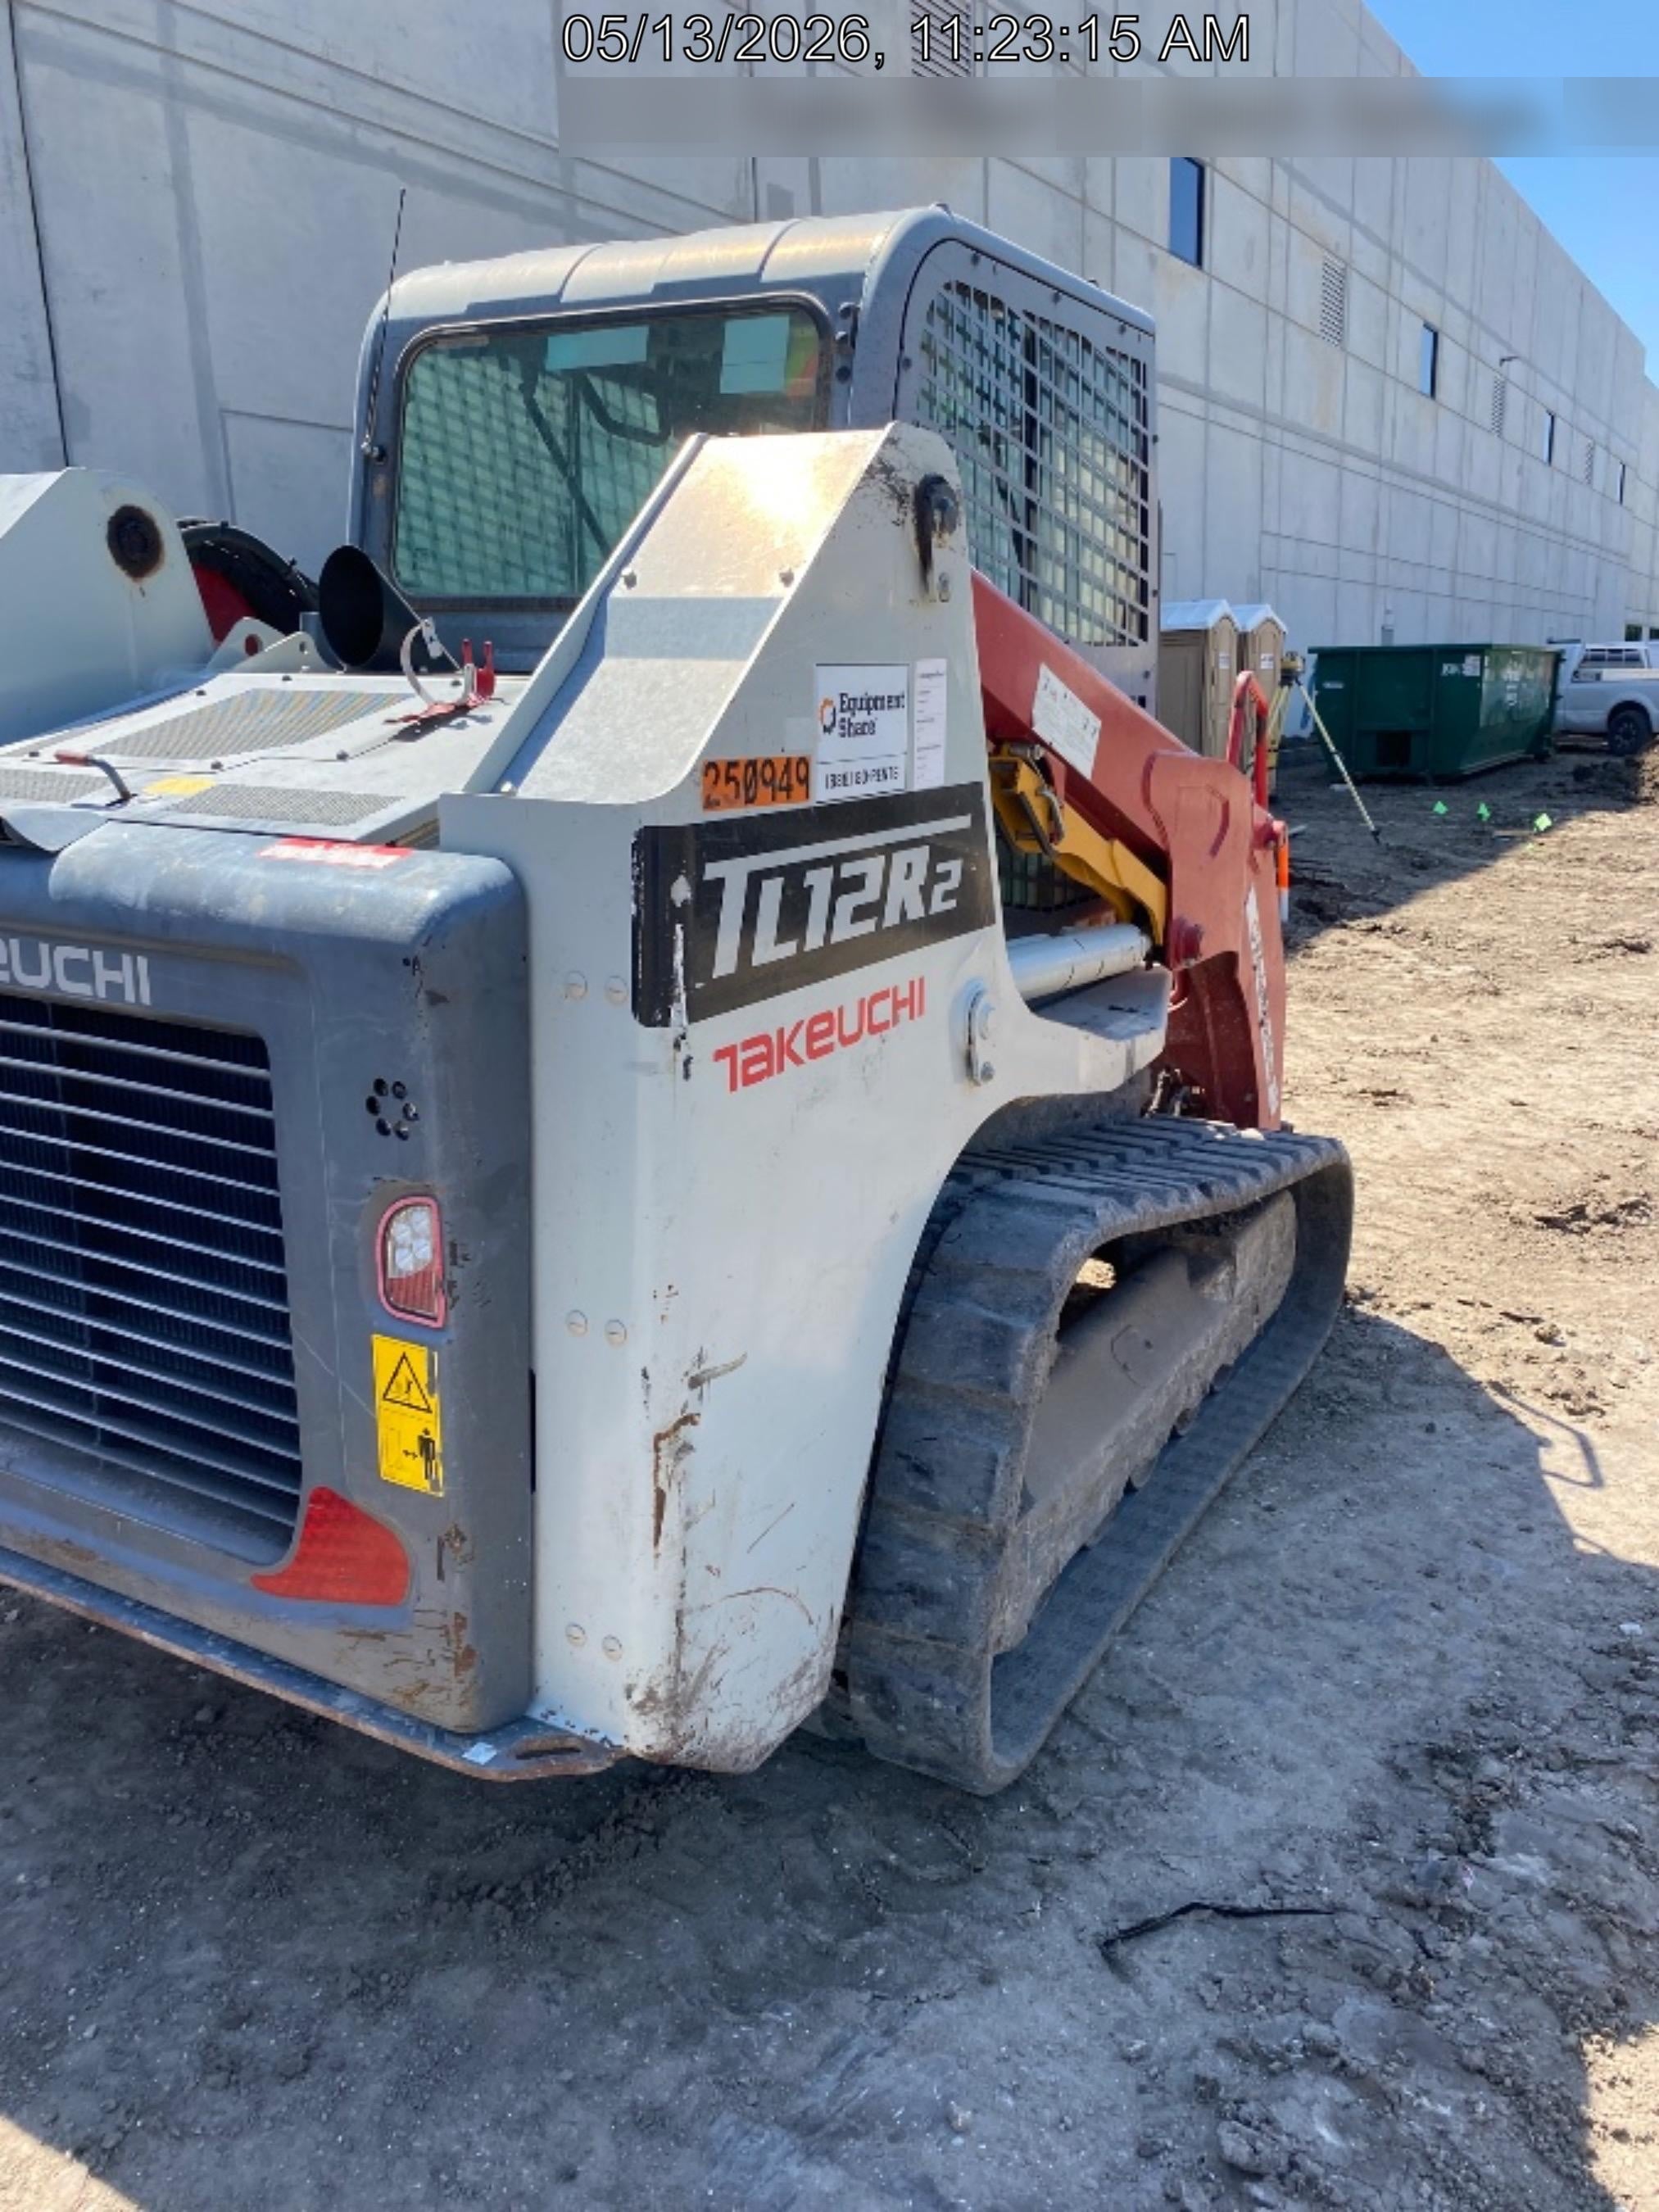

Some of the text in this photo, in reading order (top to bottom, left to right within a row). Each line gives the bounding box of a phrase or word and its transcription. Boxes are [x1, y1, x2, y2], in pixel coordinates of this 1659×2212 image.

[703, 756, 809, 805] 250949
[702, 814, 971, 980] TL12R2
[0, 937, 151, 1006] UCHI
